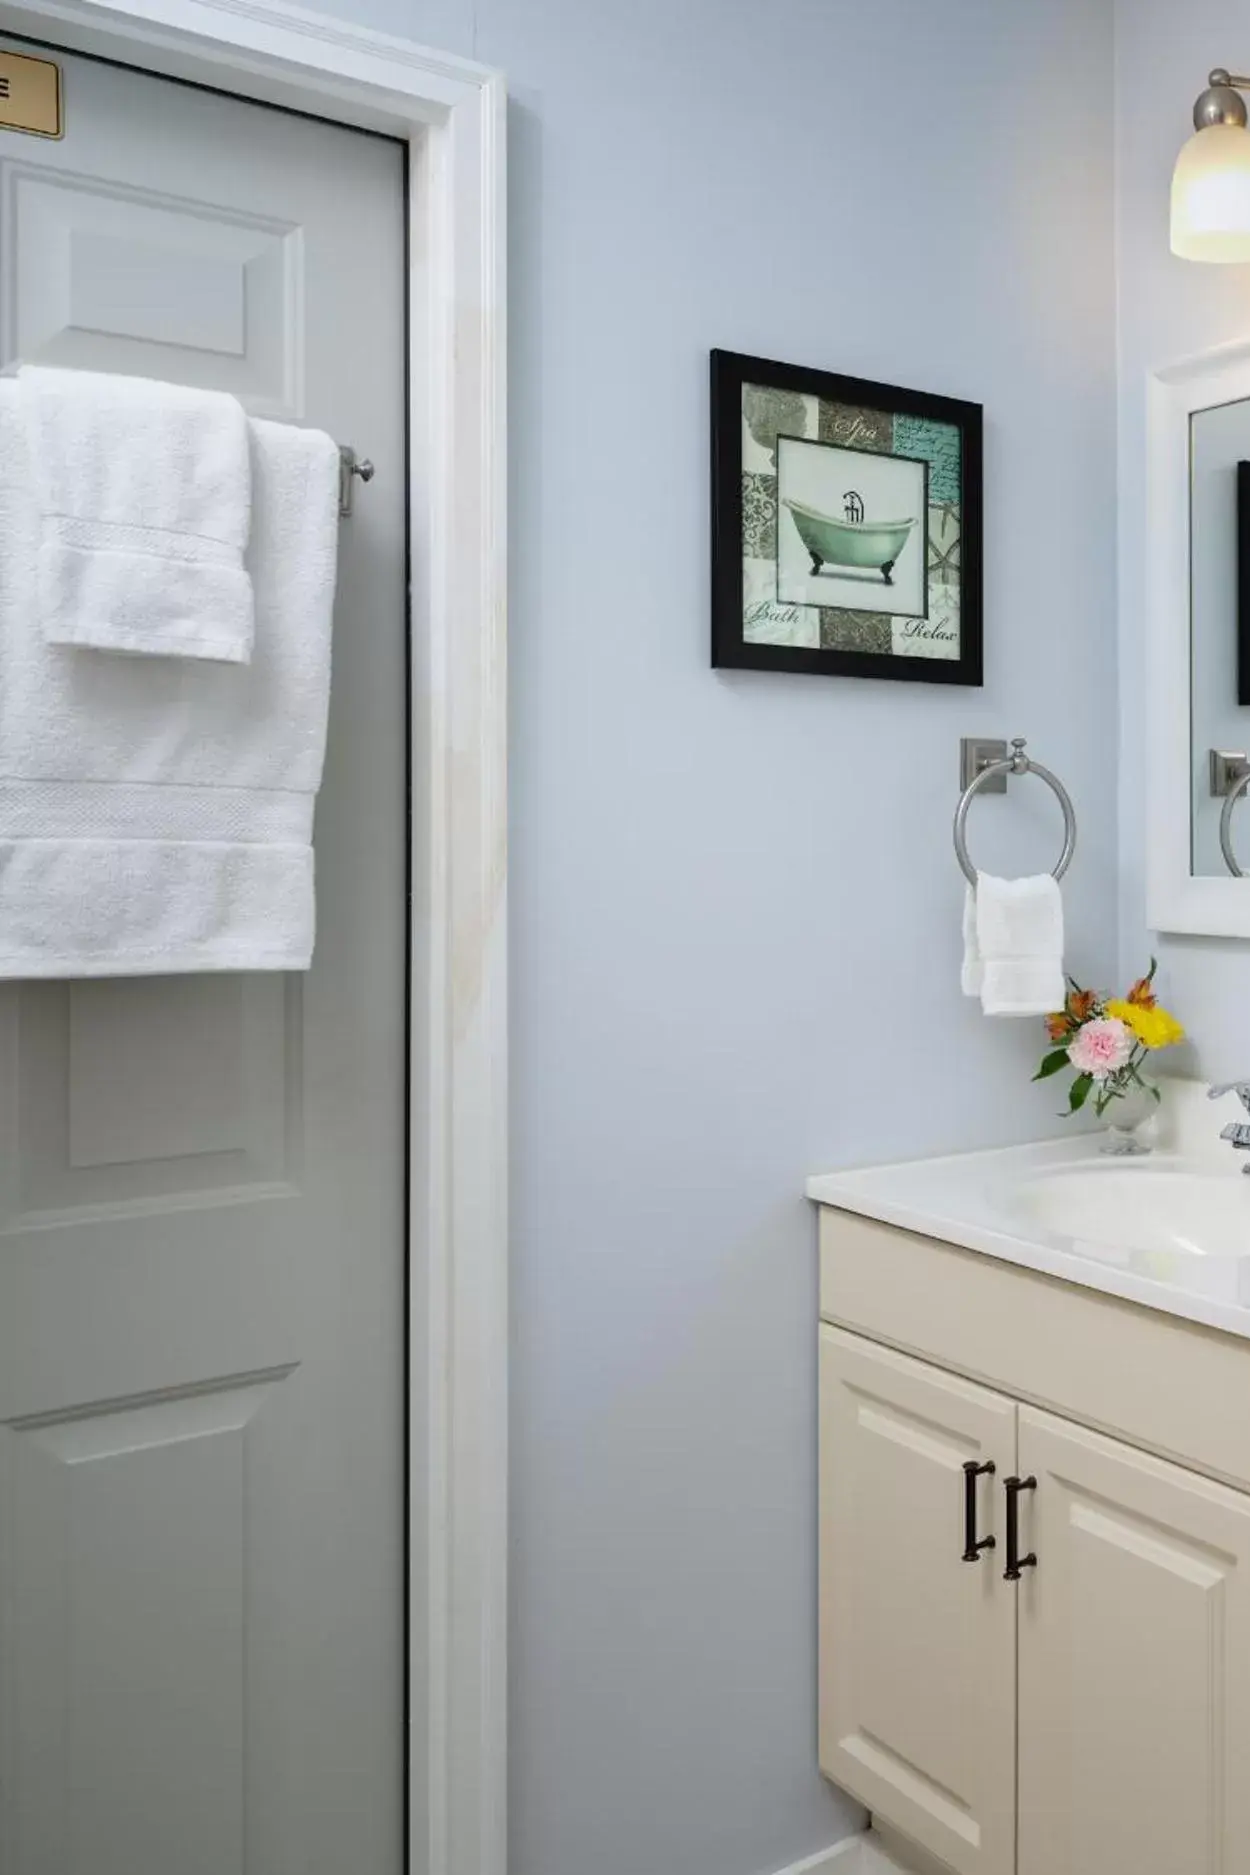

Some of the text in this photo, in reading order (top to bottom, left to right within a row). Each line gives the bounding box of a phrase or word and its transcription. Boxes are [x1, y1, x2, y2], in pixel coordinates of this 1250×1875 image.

[832, 415, 878, 447] Spa
[743, 600, 801, 627] Bath
[902, 618, 958, 642] Relax
